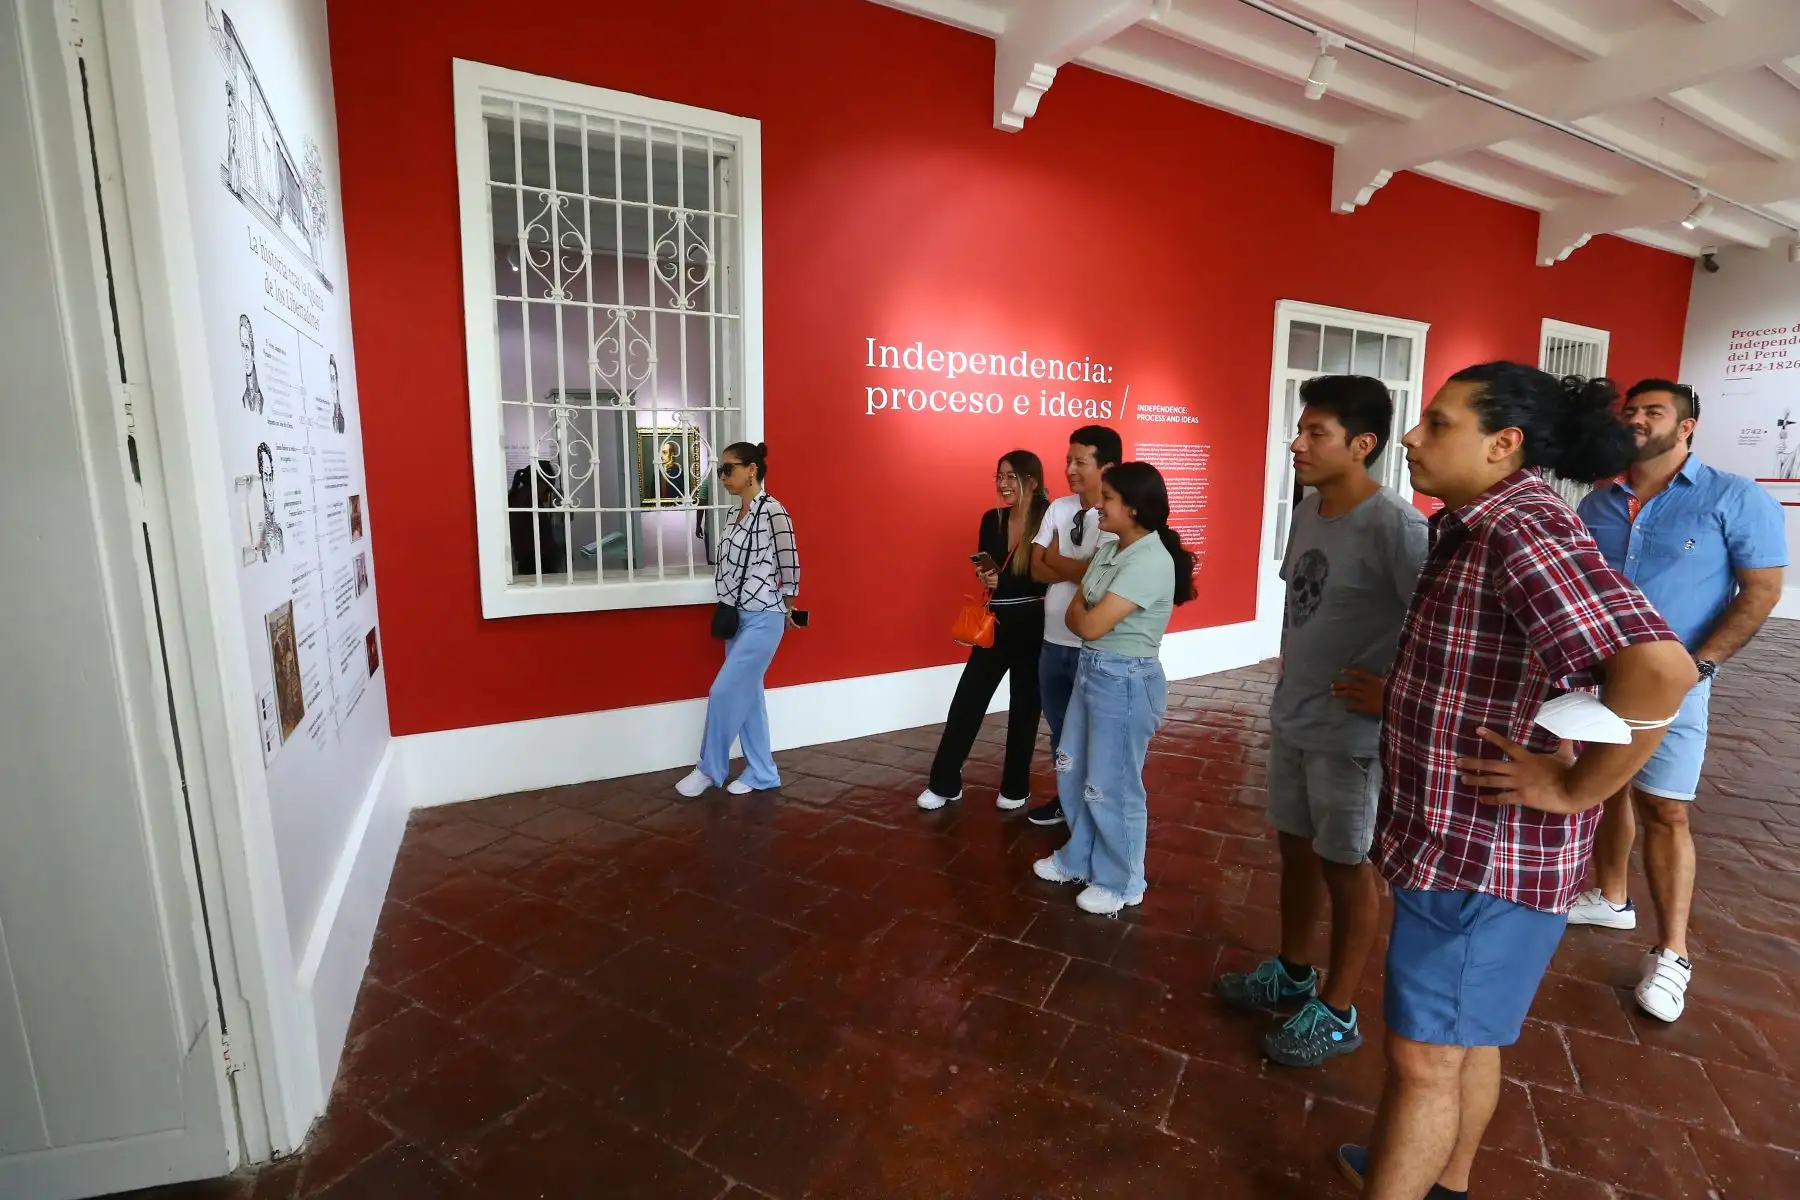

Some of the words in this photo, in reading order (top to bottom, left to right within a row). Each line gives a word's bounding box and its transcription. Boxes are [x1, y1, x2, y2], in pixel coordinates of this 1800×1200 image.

[247, 226, 259, 254] La
[1731, 327, 1787, 339] Proceso
[1729, 336, 1800, 350] independ
[865, 337, 1113, 384] Independencia:
[1728, 351, 1749, 362] del
[1754, 349, 1788, 360] Perú
[865, 386, 1004, 415] proceso
[1012, 395, 1030, 415] e
[1039, 390, 1112, 419] ideas
[1136, 404, 1188, 414] INDEPENDENCE:
[1136, 413, 1166, 422] PROCESS
[1166, 415, 1181, 423] AND
[1181, 416, 1199, 424] IDEAS
